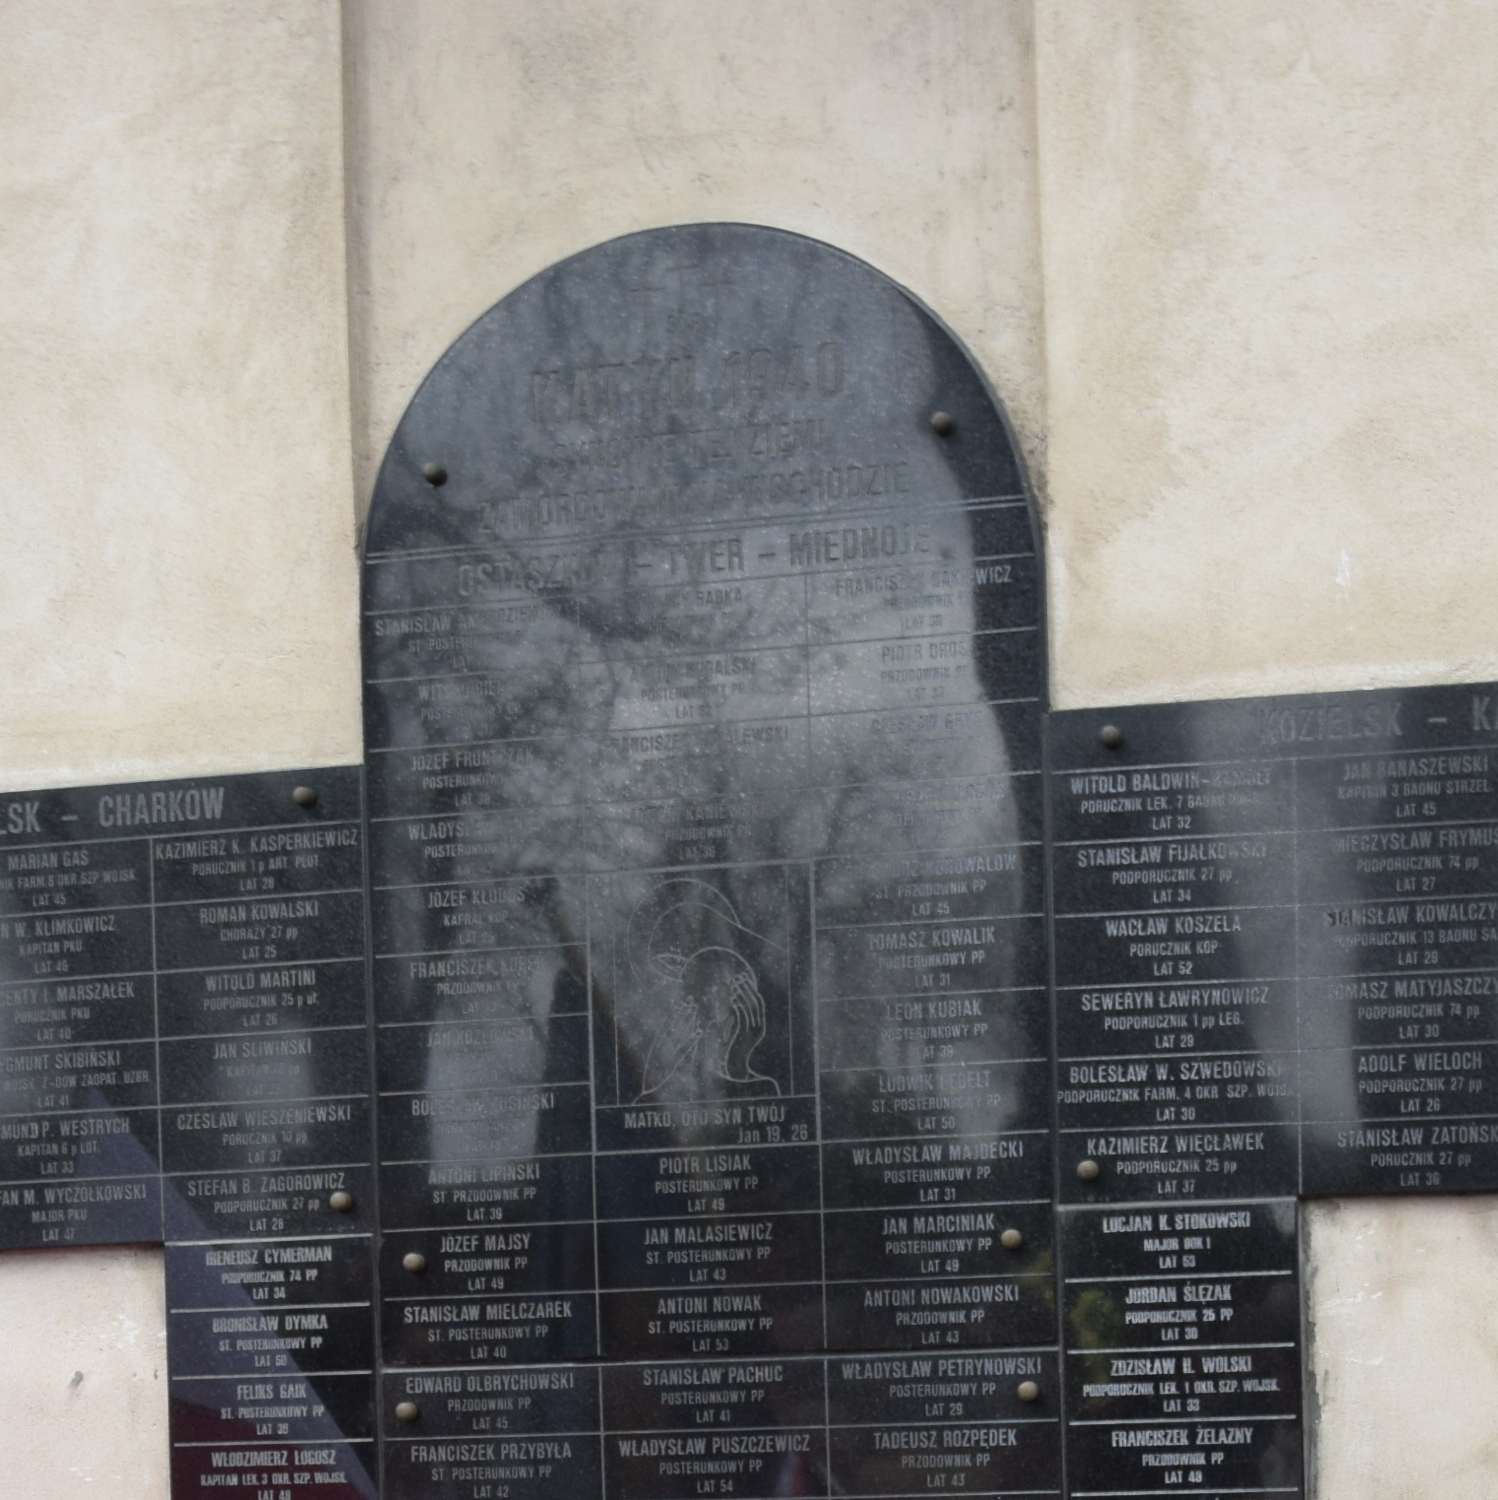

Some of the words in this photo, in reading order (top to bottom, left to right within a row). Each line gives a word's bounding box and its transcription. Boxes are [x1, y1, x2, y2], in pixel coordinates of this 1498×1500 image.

[200, 906, 246, 924] ROMAN
[252, 901, 318, 920] KOWALSKI
[1106, 918, 1169, 937] WACŁAW
[1175, 915, 1241, 934] KOSZELA
[1130, 942, 1191, 957] PORUCZNIK
[1197, 941, 1218, 954] KOP
[1154, 963, 1174, 976] LAT
[1179, 962, 1192, 974] 52
[1358, 1055, 1406, 1073] ADOLF
[1415, 1053, 1482, 1071] WIELOCH
[682, 1110, 708, 1126] OTO
[714, 1108, 741, 1125] SYN
[748, 1105, 785, 1123] TWÓJ
[737, 1127, 759, 1143] Jan
[791, 1124, 808, 1141] 26
